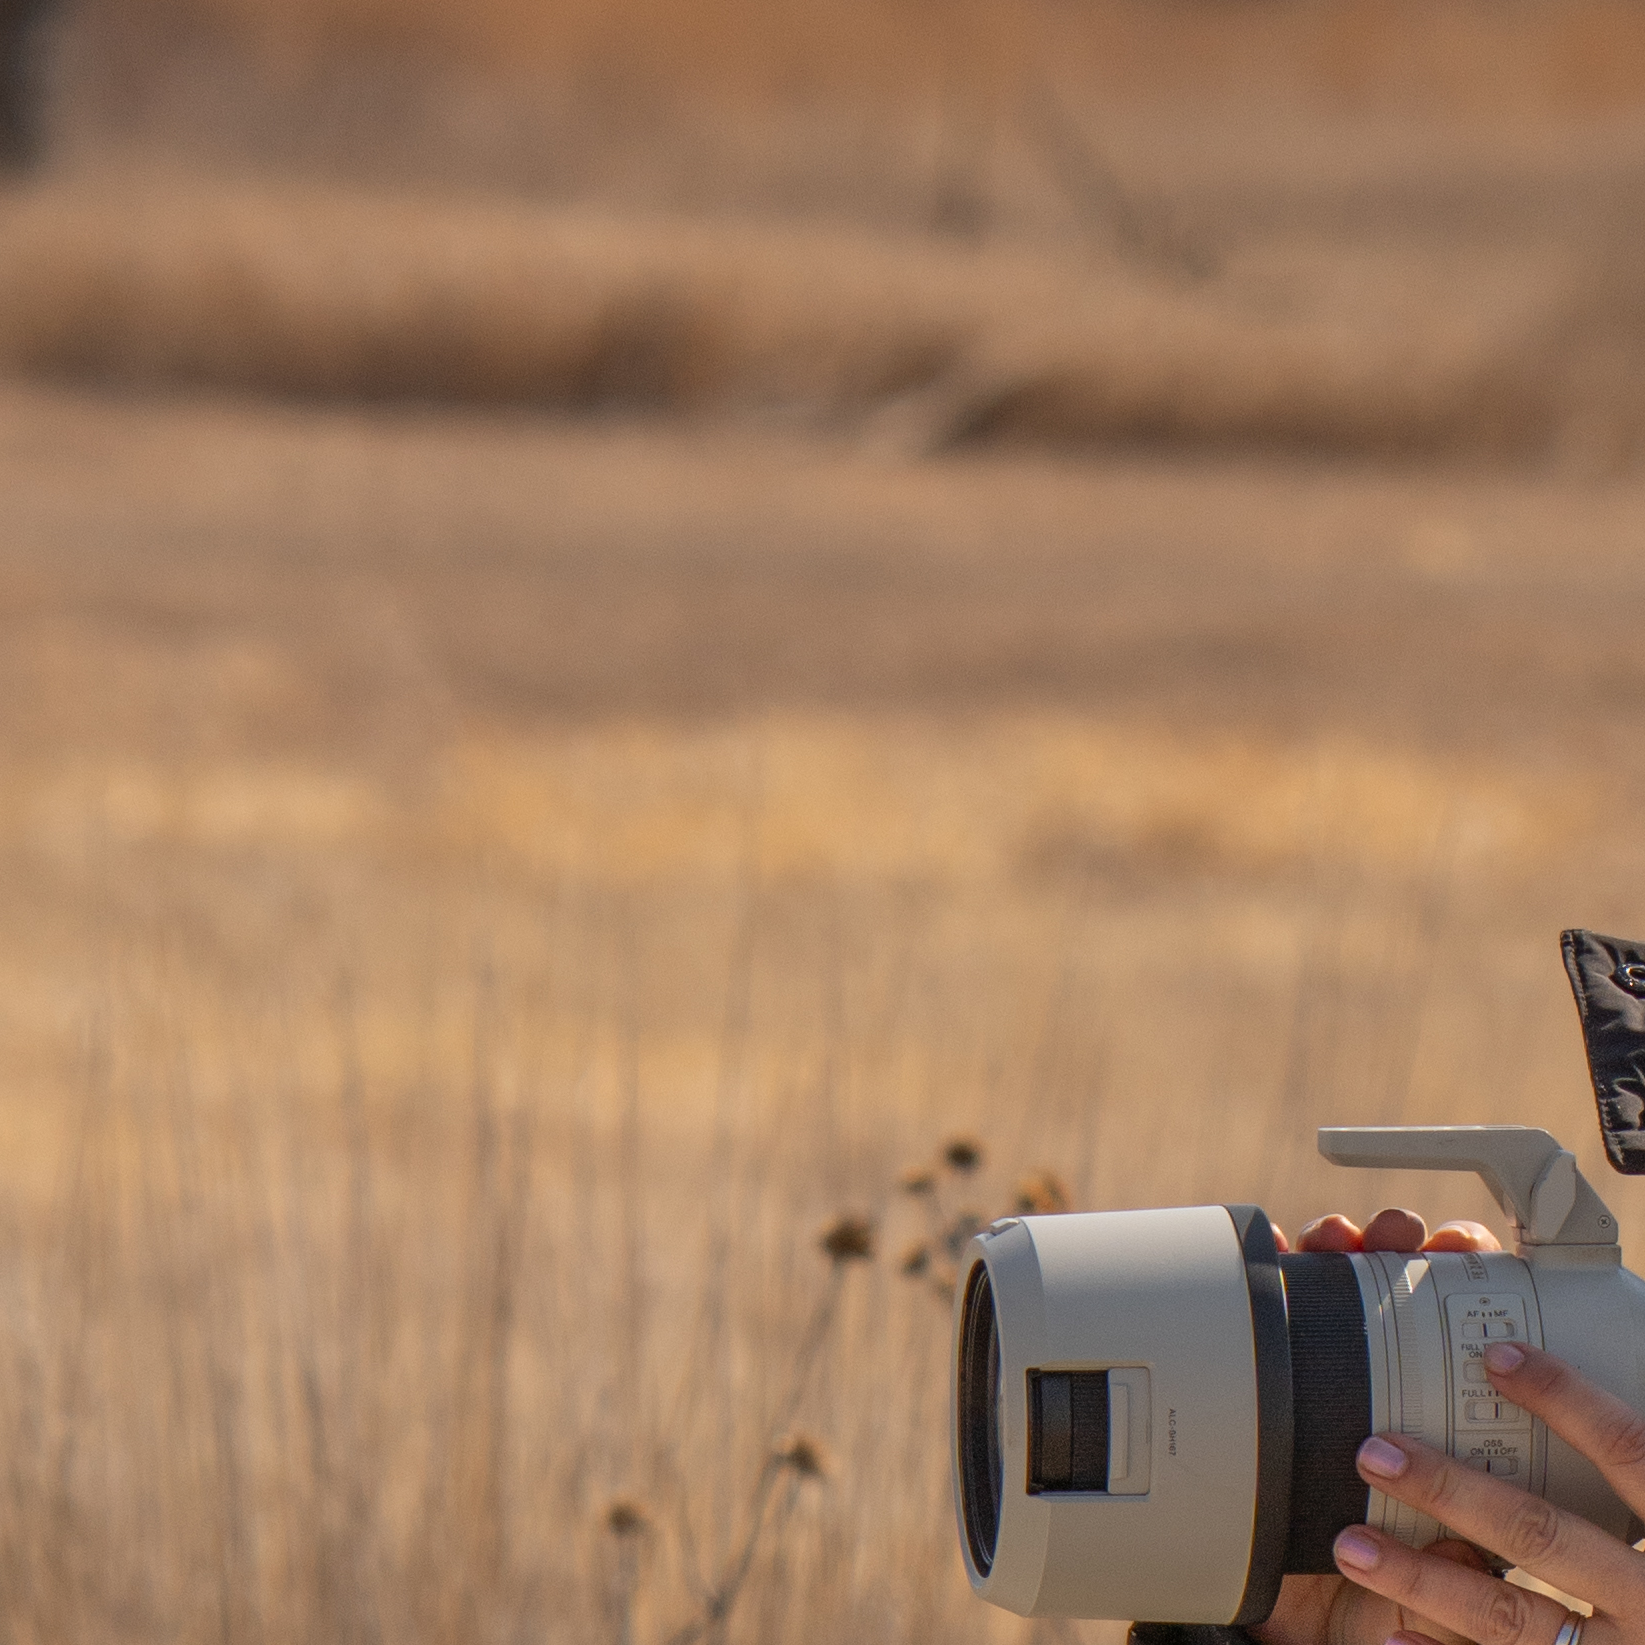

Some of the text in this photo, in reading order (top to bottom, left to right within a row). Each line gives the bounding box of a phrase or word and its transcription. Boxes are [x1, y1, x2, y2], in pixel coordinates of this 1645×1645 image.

[1467, 1310, 1508, 1318] AF MF
[1461, 1343, 1480, 1351] FULL
[1469, 1351, 1483, 1359] ON
[1462, 1389, 1486, 1397] FULL
[1500, 1447, 1518, 1455] OFF
